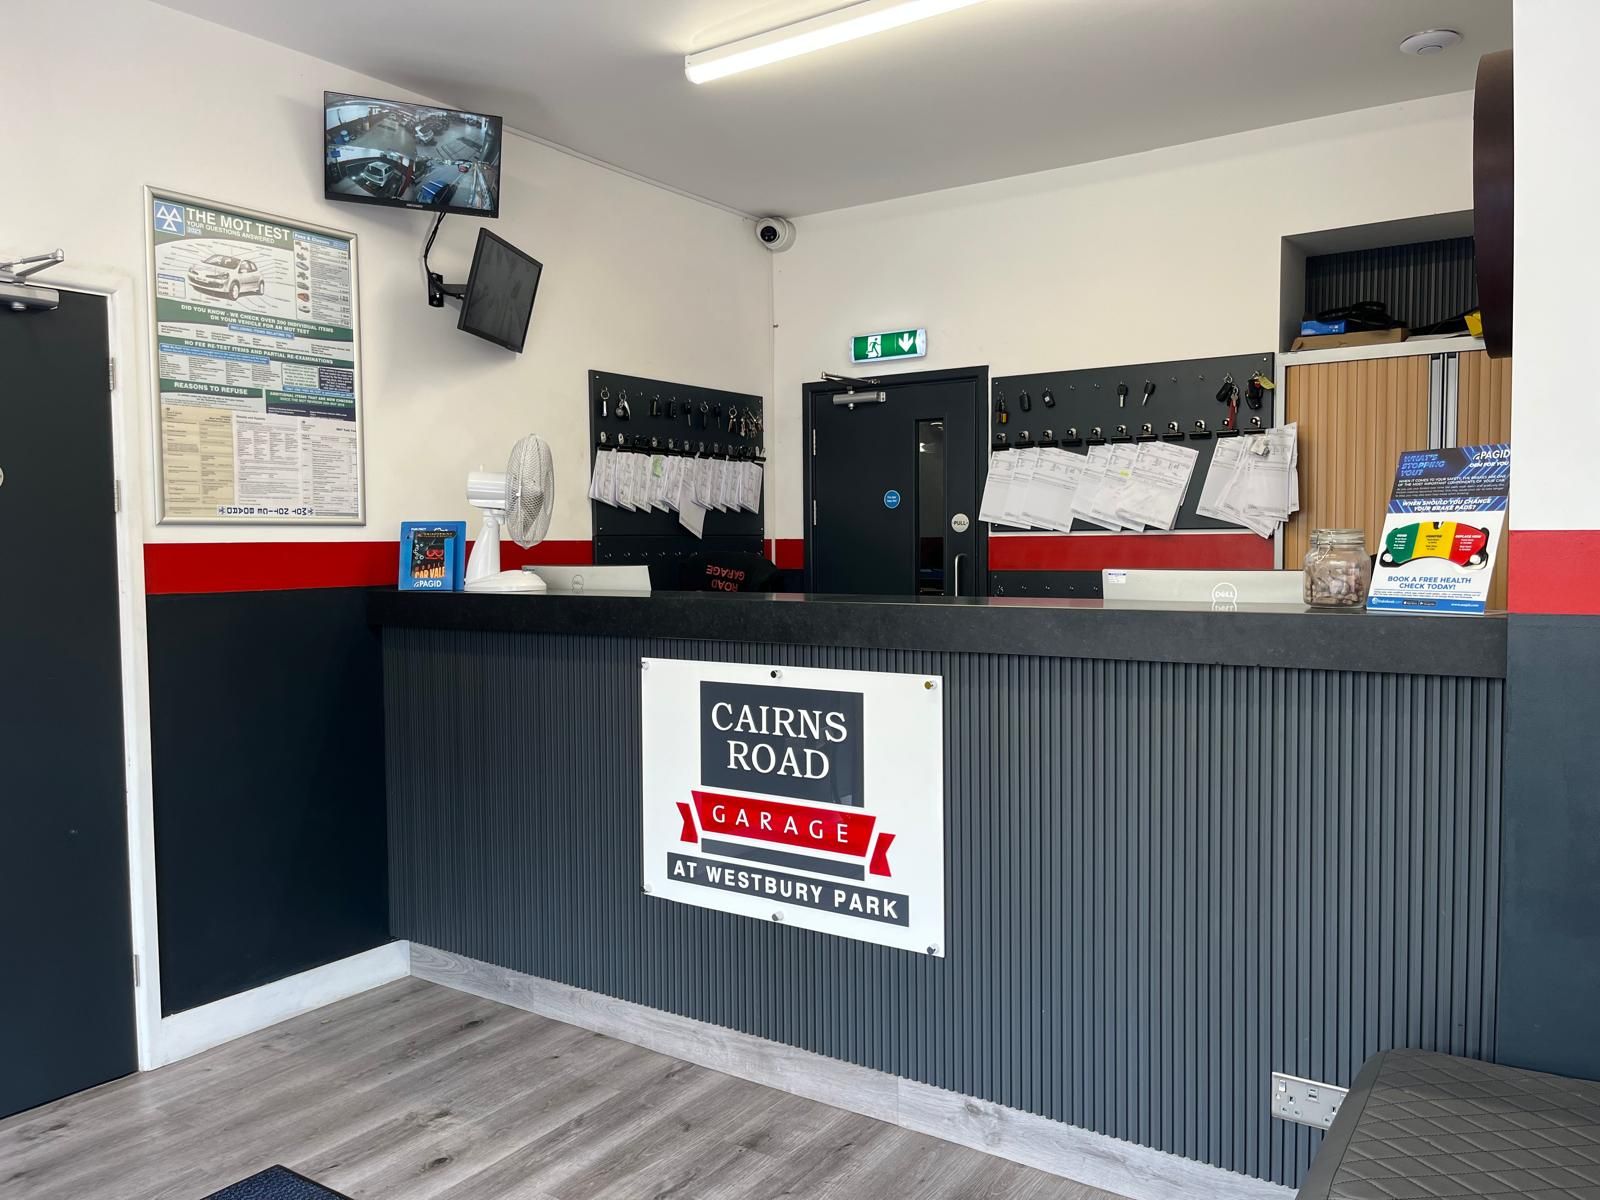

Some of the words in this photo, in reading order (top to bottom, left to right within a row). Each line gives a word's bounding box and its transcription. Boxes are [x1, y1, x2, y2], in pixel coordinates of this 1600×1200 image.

[186, 208, 216, 225] THE
[220, 215, 252, 232] MOT
[256, 222, 290, 240] TEST
[187, 221, 204, 229] YOUR
[206, 224, 240, 237] QUESTIONS
[242, 232, 274, 244] ANSWERED
[288, 320, 317, 330] INDIVIDUAL
[207, 343, 230, 351] RE-TEST
[174, 382, 208, 391] REASONS
[221, 387, 248, 395] REFUSE
[1480, 450, 1510, 459] PAGID
[1401, 460, 1445, 470] STOPPING
[415, 570, 429, 578] CAR
[706, 565, 745, 580] GARAGE
[711, 579, 738, 592] ROAD
[711, 702, 848, 742] CAIRNS
[727, 740, 830, 779] ROAD
[712, 805, 848, 843] GARAGE
[674, 860, 698, 878] AT
[706, 865, 823, 904] WESTBURY
[834, 889, 898, 919] PARK
